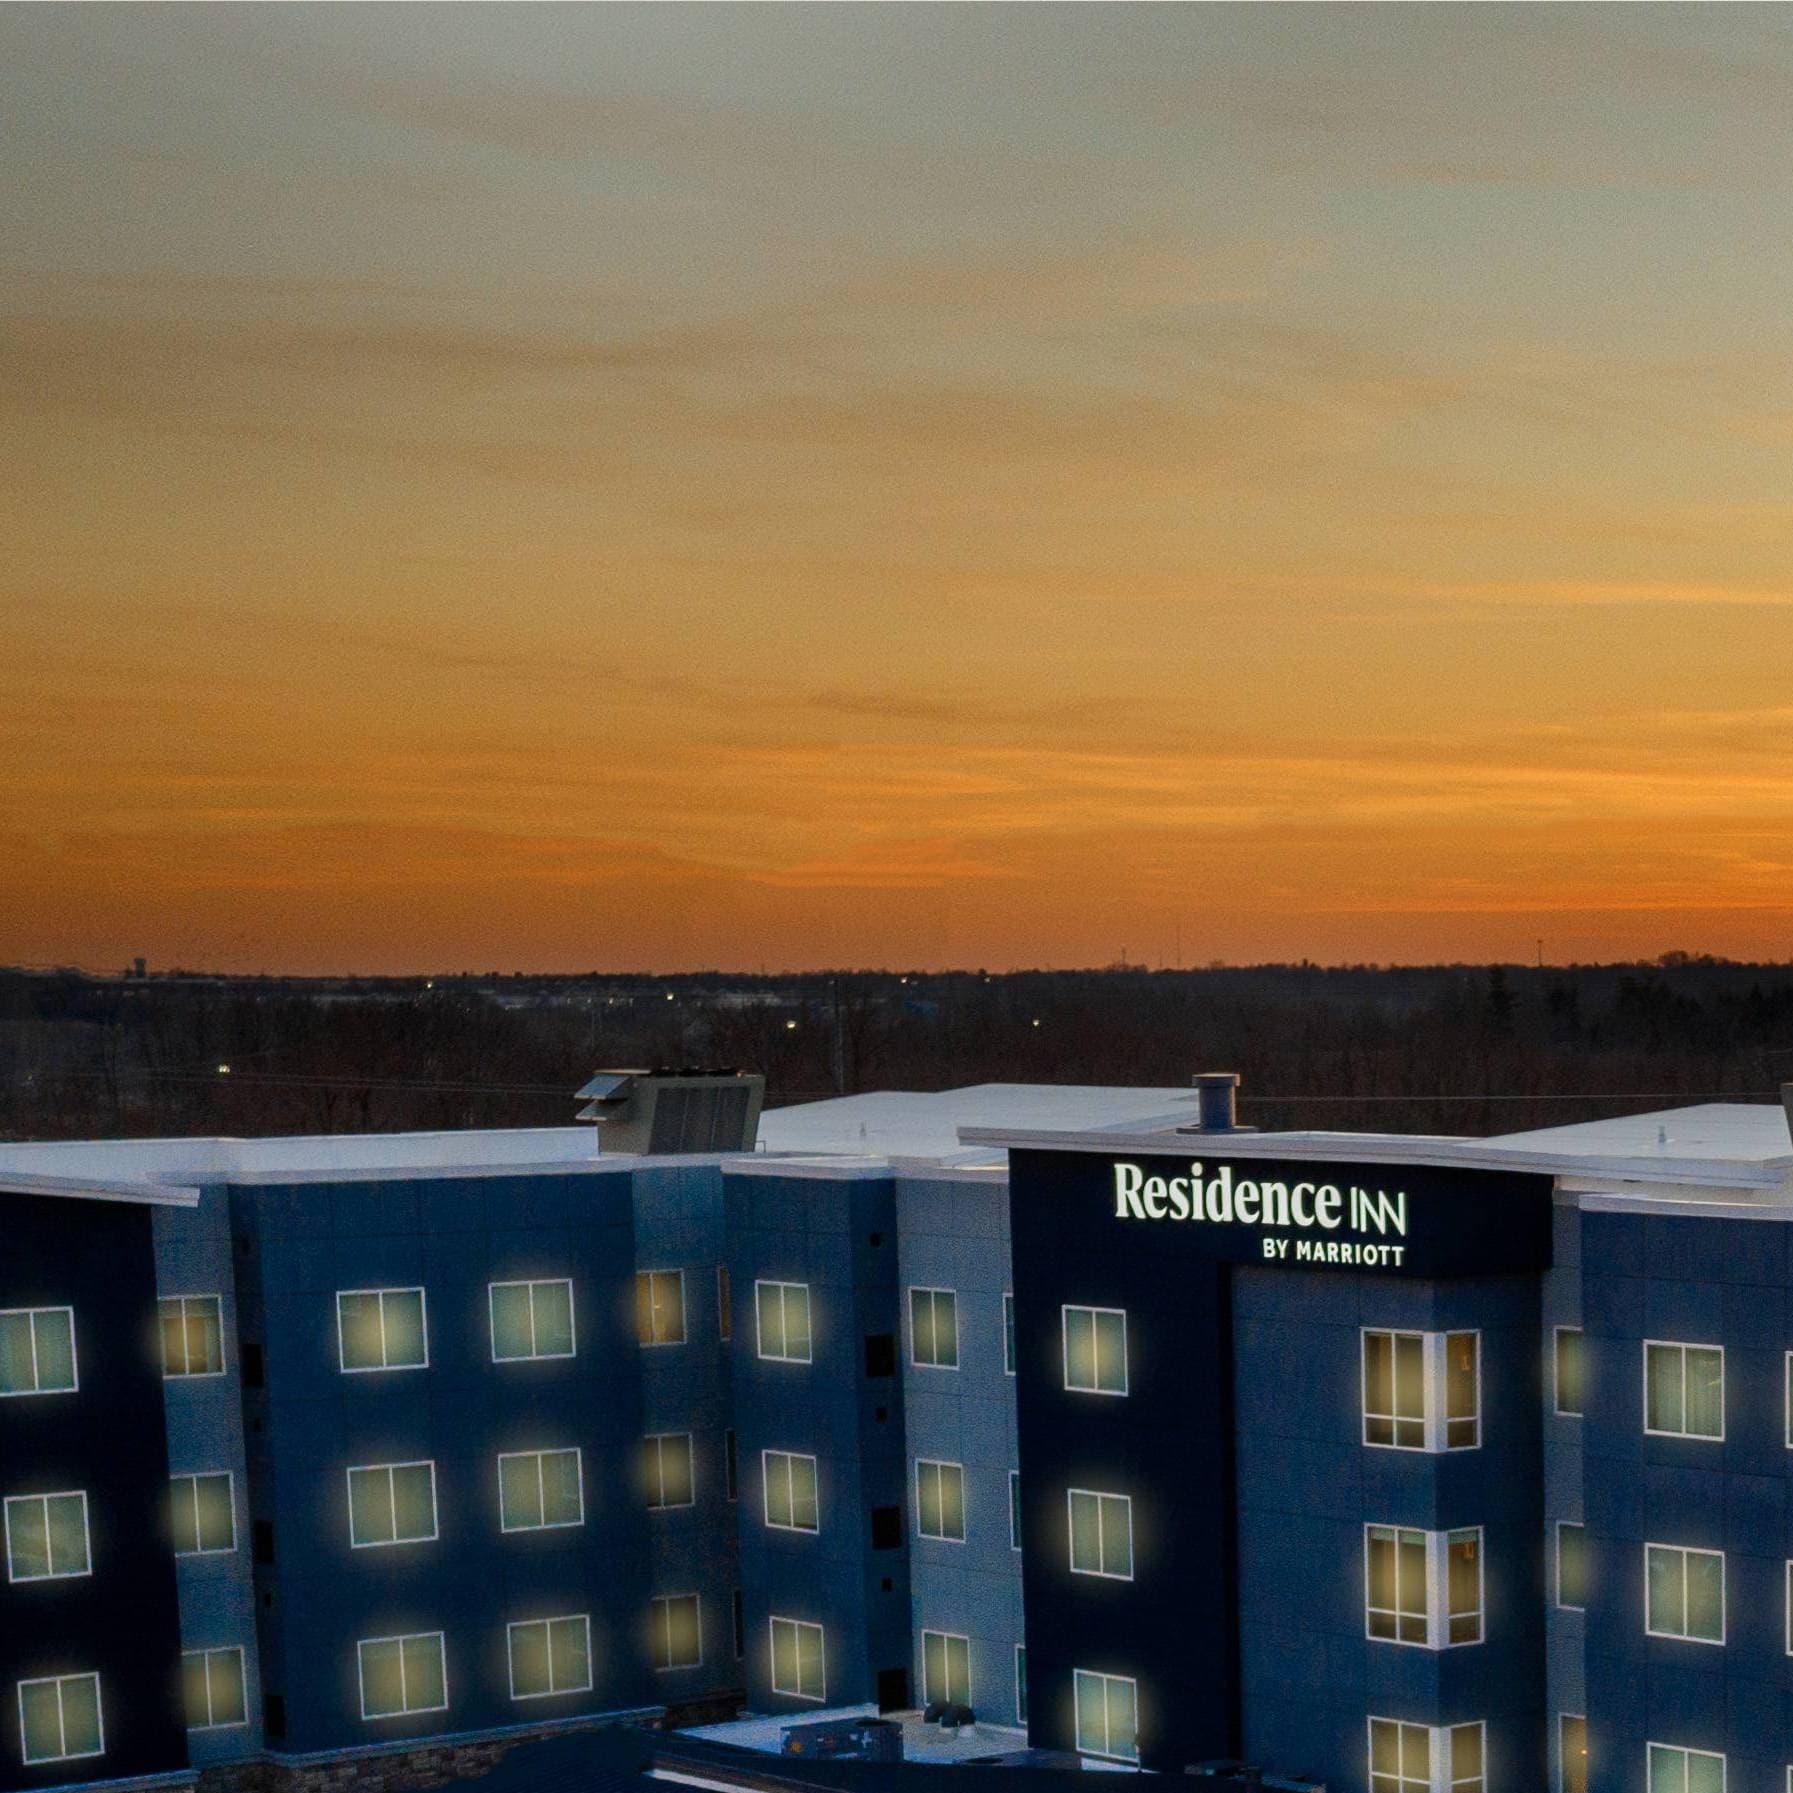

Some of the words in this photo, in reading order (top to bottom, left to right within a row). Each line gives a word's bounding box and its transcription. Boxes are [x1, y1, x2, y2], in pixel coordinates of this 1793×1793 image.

[1113, 1161, 1342, 1229] Residence
[1350, 1186, 1406, 1237] INN
[1262, 1237, 1289, 1259] BY
[1296, 1240, 1405, 1267] MARRIOTT
